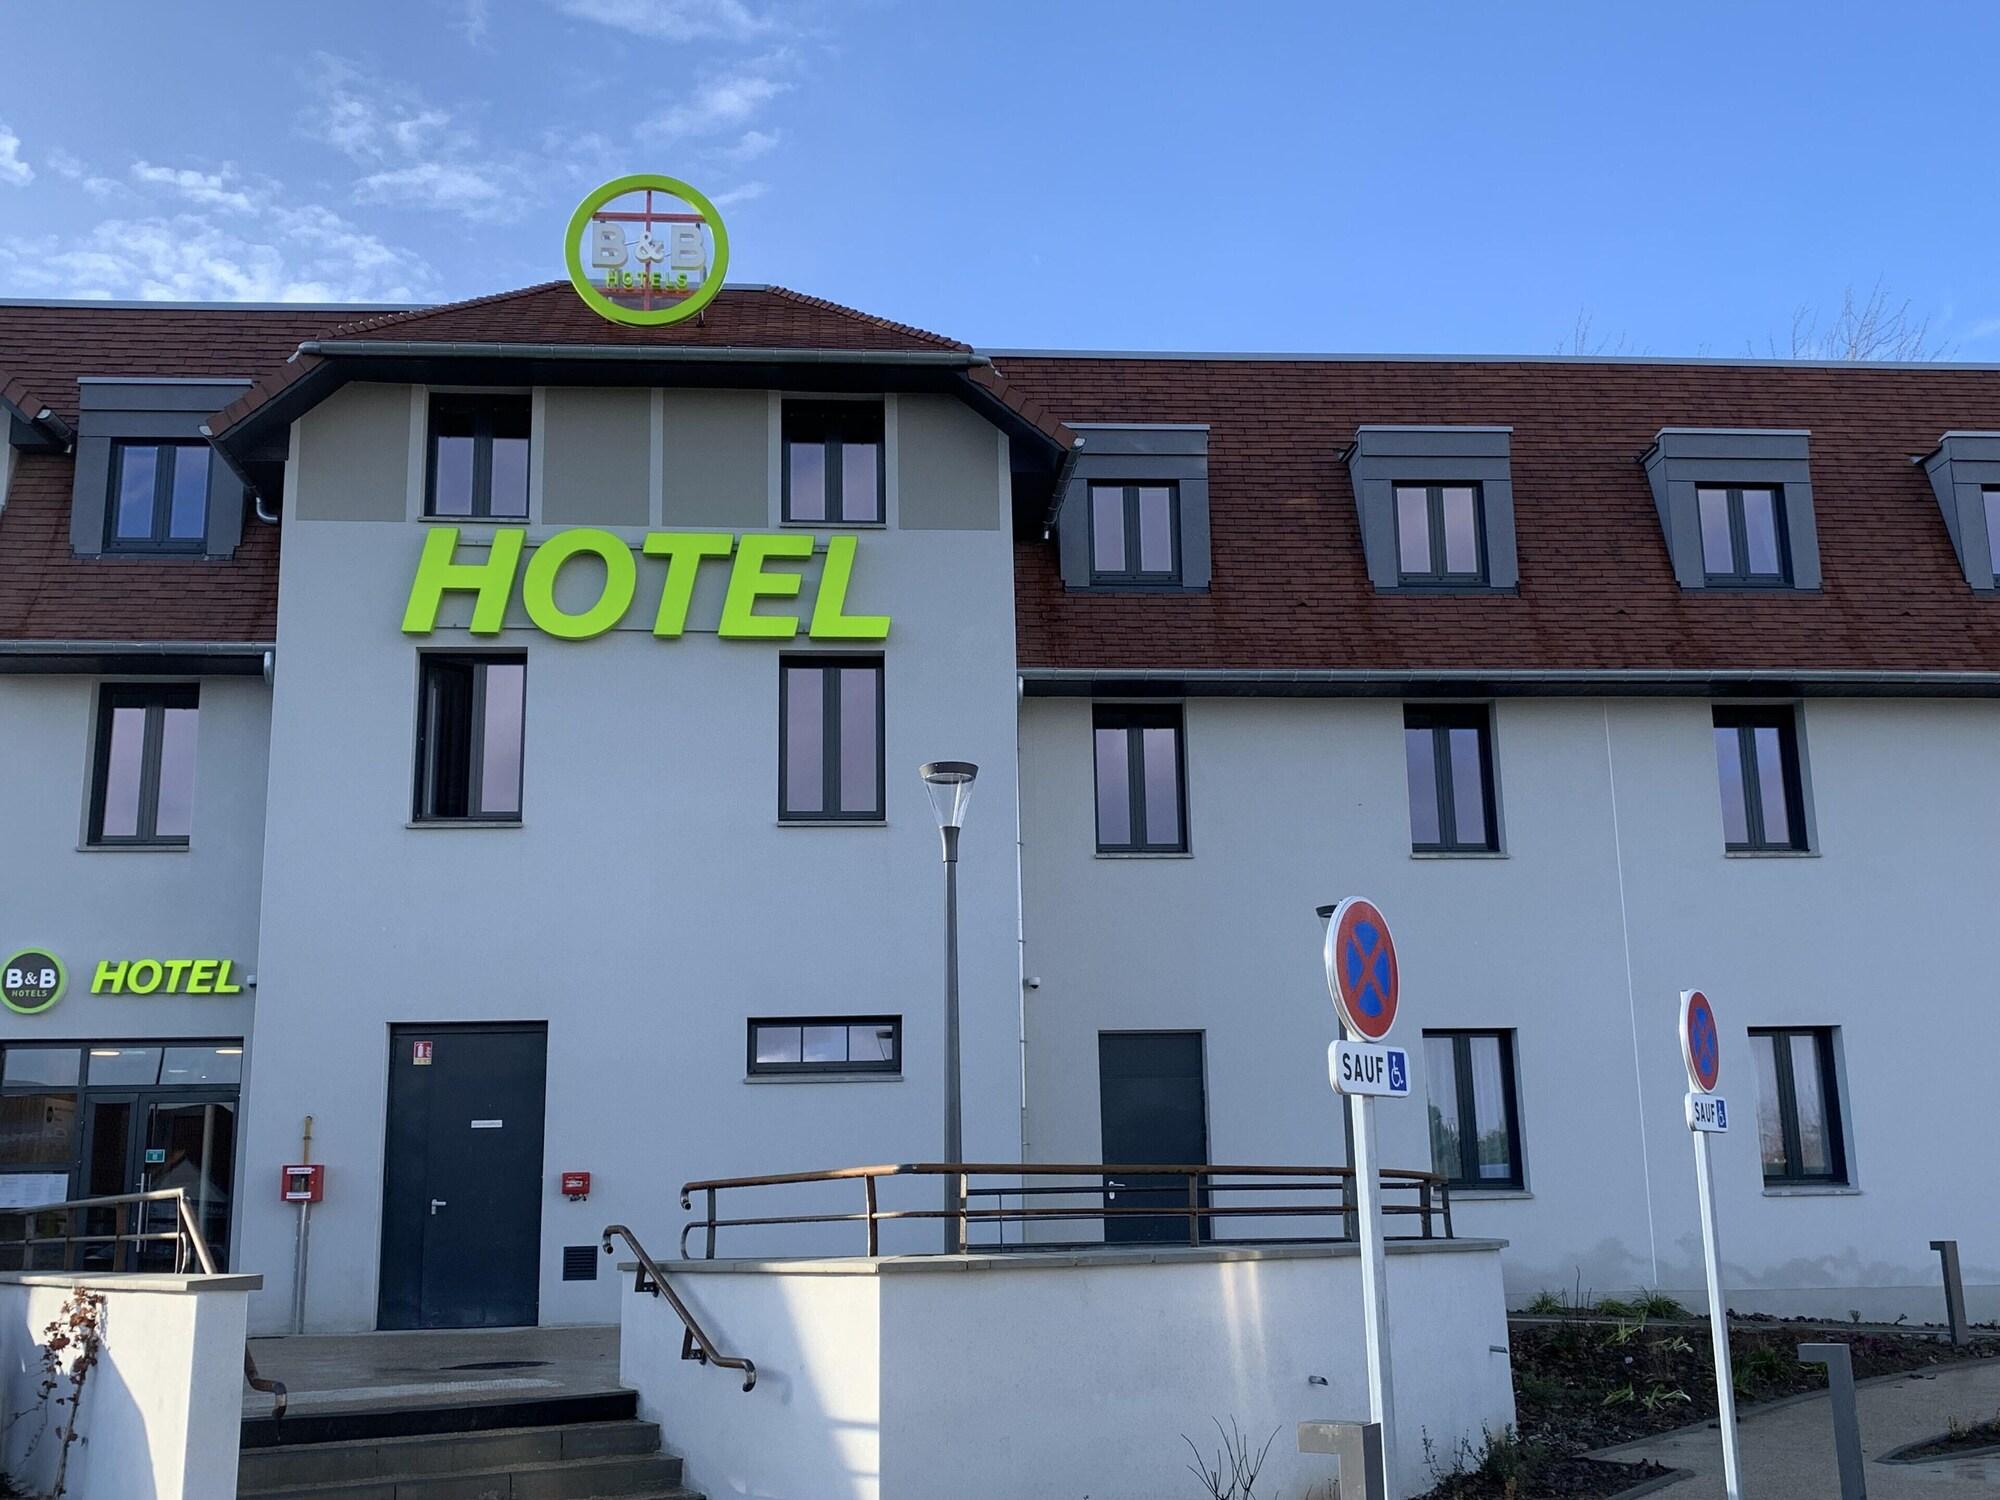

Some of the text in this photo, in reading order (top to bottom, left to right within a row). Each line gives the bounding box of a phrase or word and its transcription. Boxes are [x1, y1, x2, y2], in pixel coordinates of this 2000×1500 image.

[592, 222, 707, 270] B&B
[606, 271, 688, 291] HOTELS
[401, 527, 893, 640] HOTEL
[6, 968, 56, 988] B&B
[90, 958, 242, 994] HOTEL
[11, 989, 48, 998] HOTELS
[1342, 1052, 1384, 1084] SAUF
[1694, 1101, 1715, 1123] SAUF
